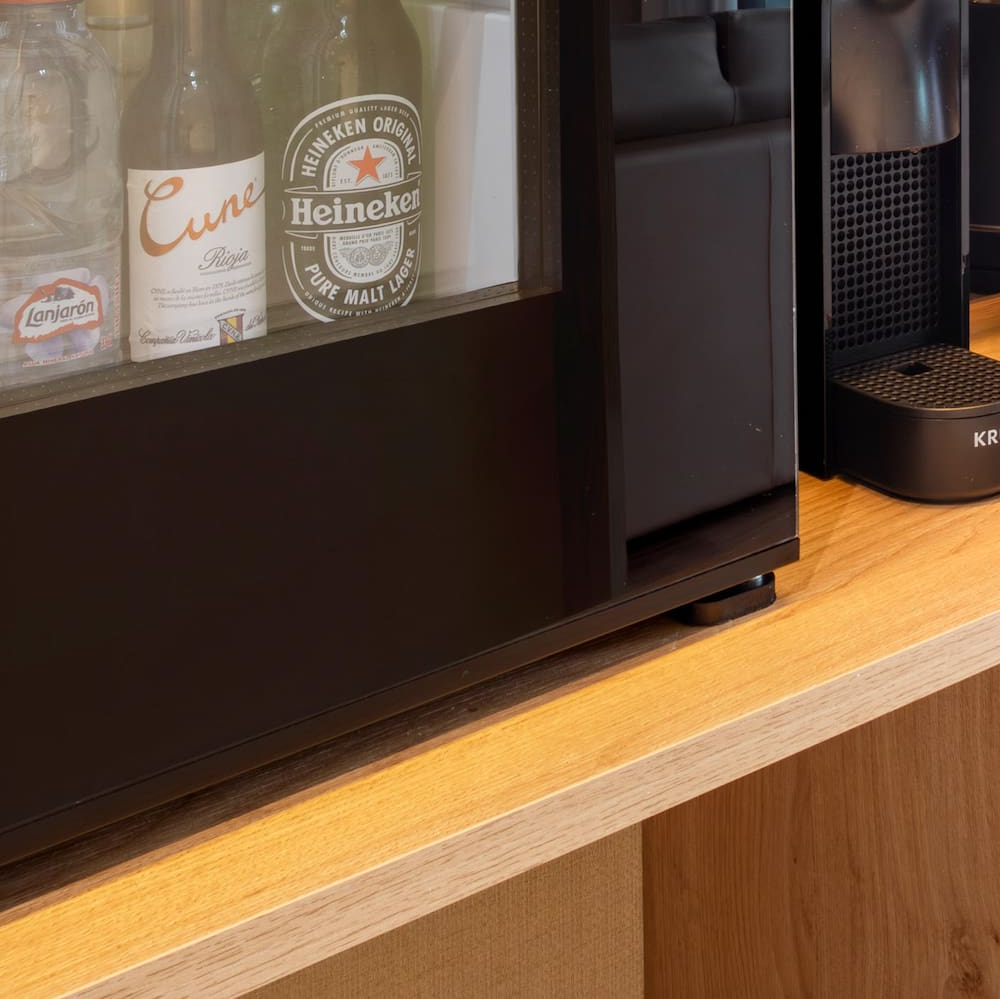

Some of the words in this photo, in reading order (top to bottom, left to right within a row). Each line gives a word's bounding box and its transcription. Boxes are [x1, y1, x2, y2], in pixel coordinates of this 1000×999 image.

[301, 118, 367, 177] HEINEKEN
[373, 116, 417, 165] ORIGINAL
[139, 177, 265, 257] Cune
[291, 188, 421, 226] Heineken
[198, 246, 249, 271] Rioja
[305, 264, 341, 300] PURE
[344, 285, 386, 305] MALT
[389, 248, 416, 294] LAGER
[25, 300, 94, 327] Lanjarón
